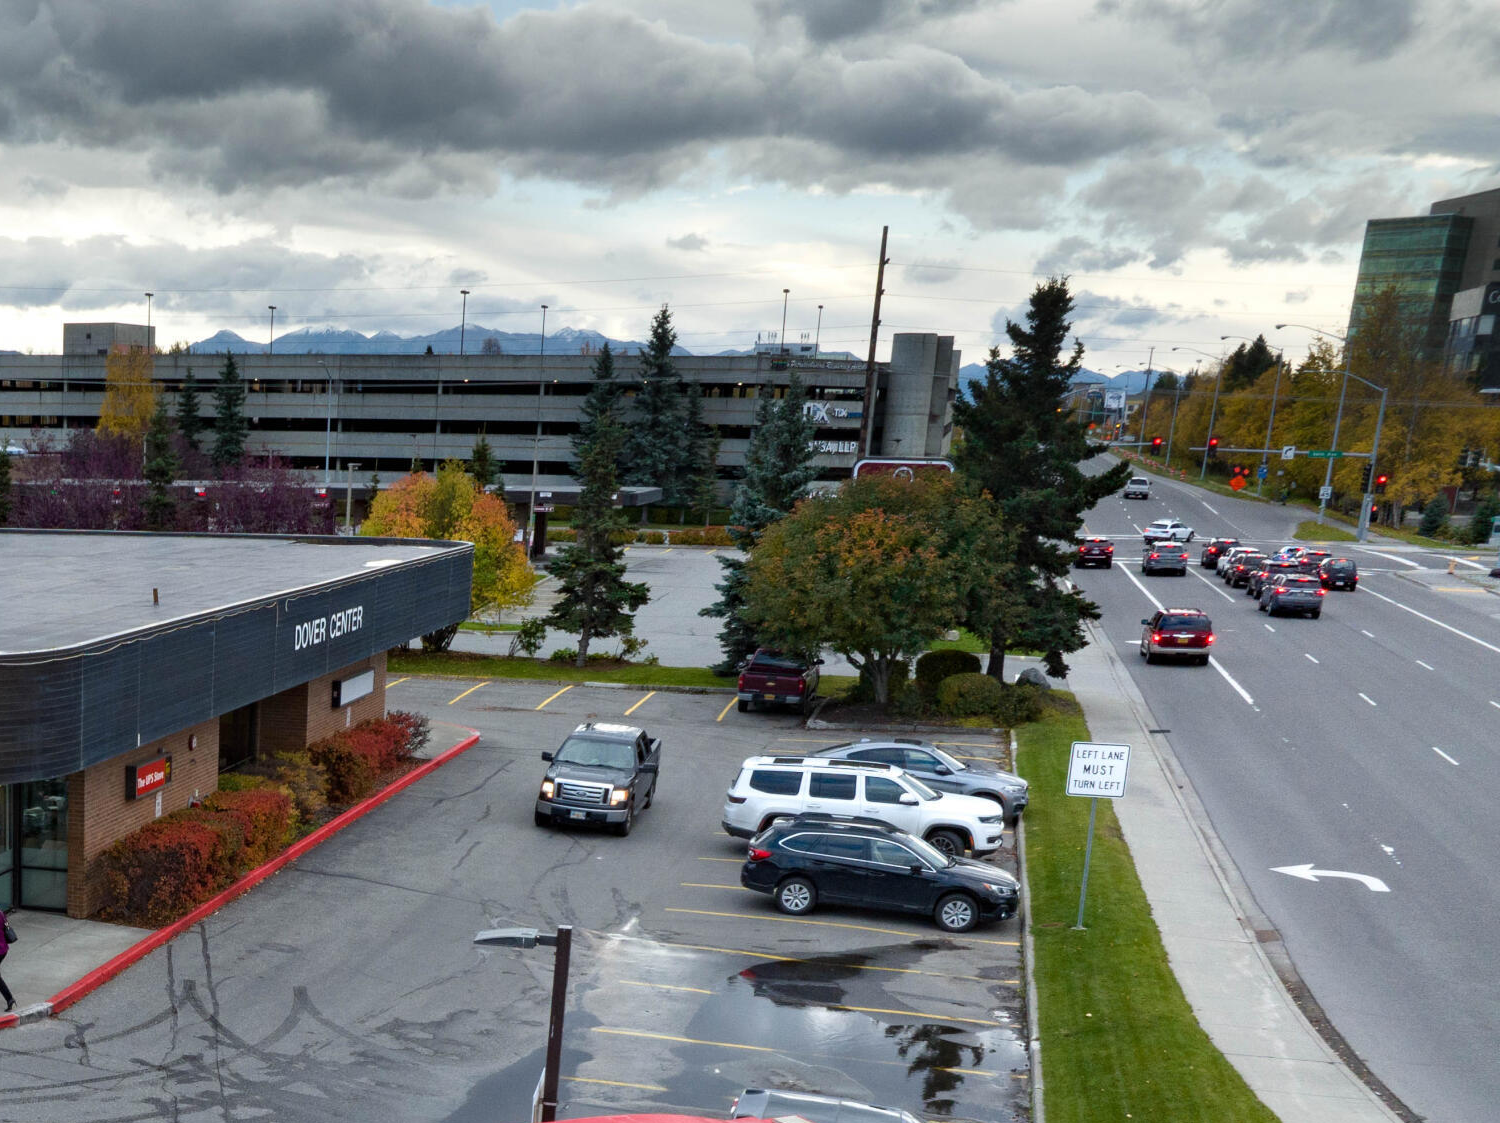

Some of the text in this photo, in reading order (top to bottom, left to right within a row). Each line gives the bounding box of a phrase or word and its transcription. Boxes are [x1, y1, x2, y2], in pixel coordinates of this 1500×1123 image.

[294, 605, 363, 651] DOVER CENTER
[1076, 750, 1125, 760] LEFT LANE
[1083, 764, 1114, 775] MUST
[1073, 779, 1120, 790] TURN LEFT
